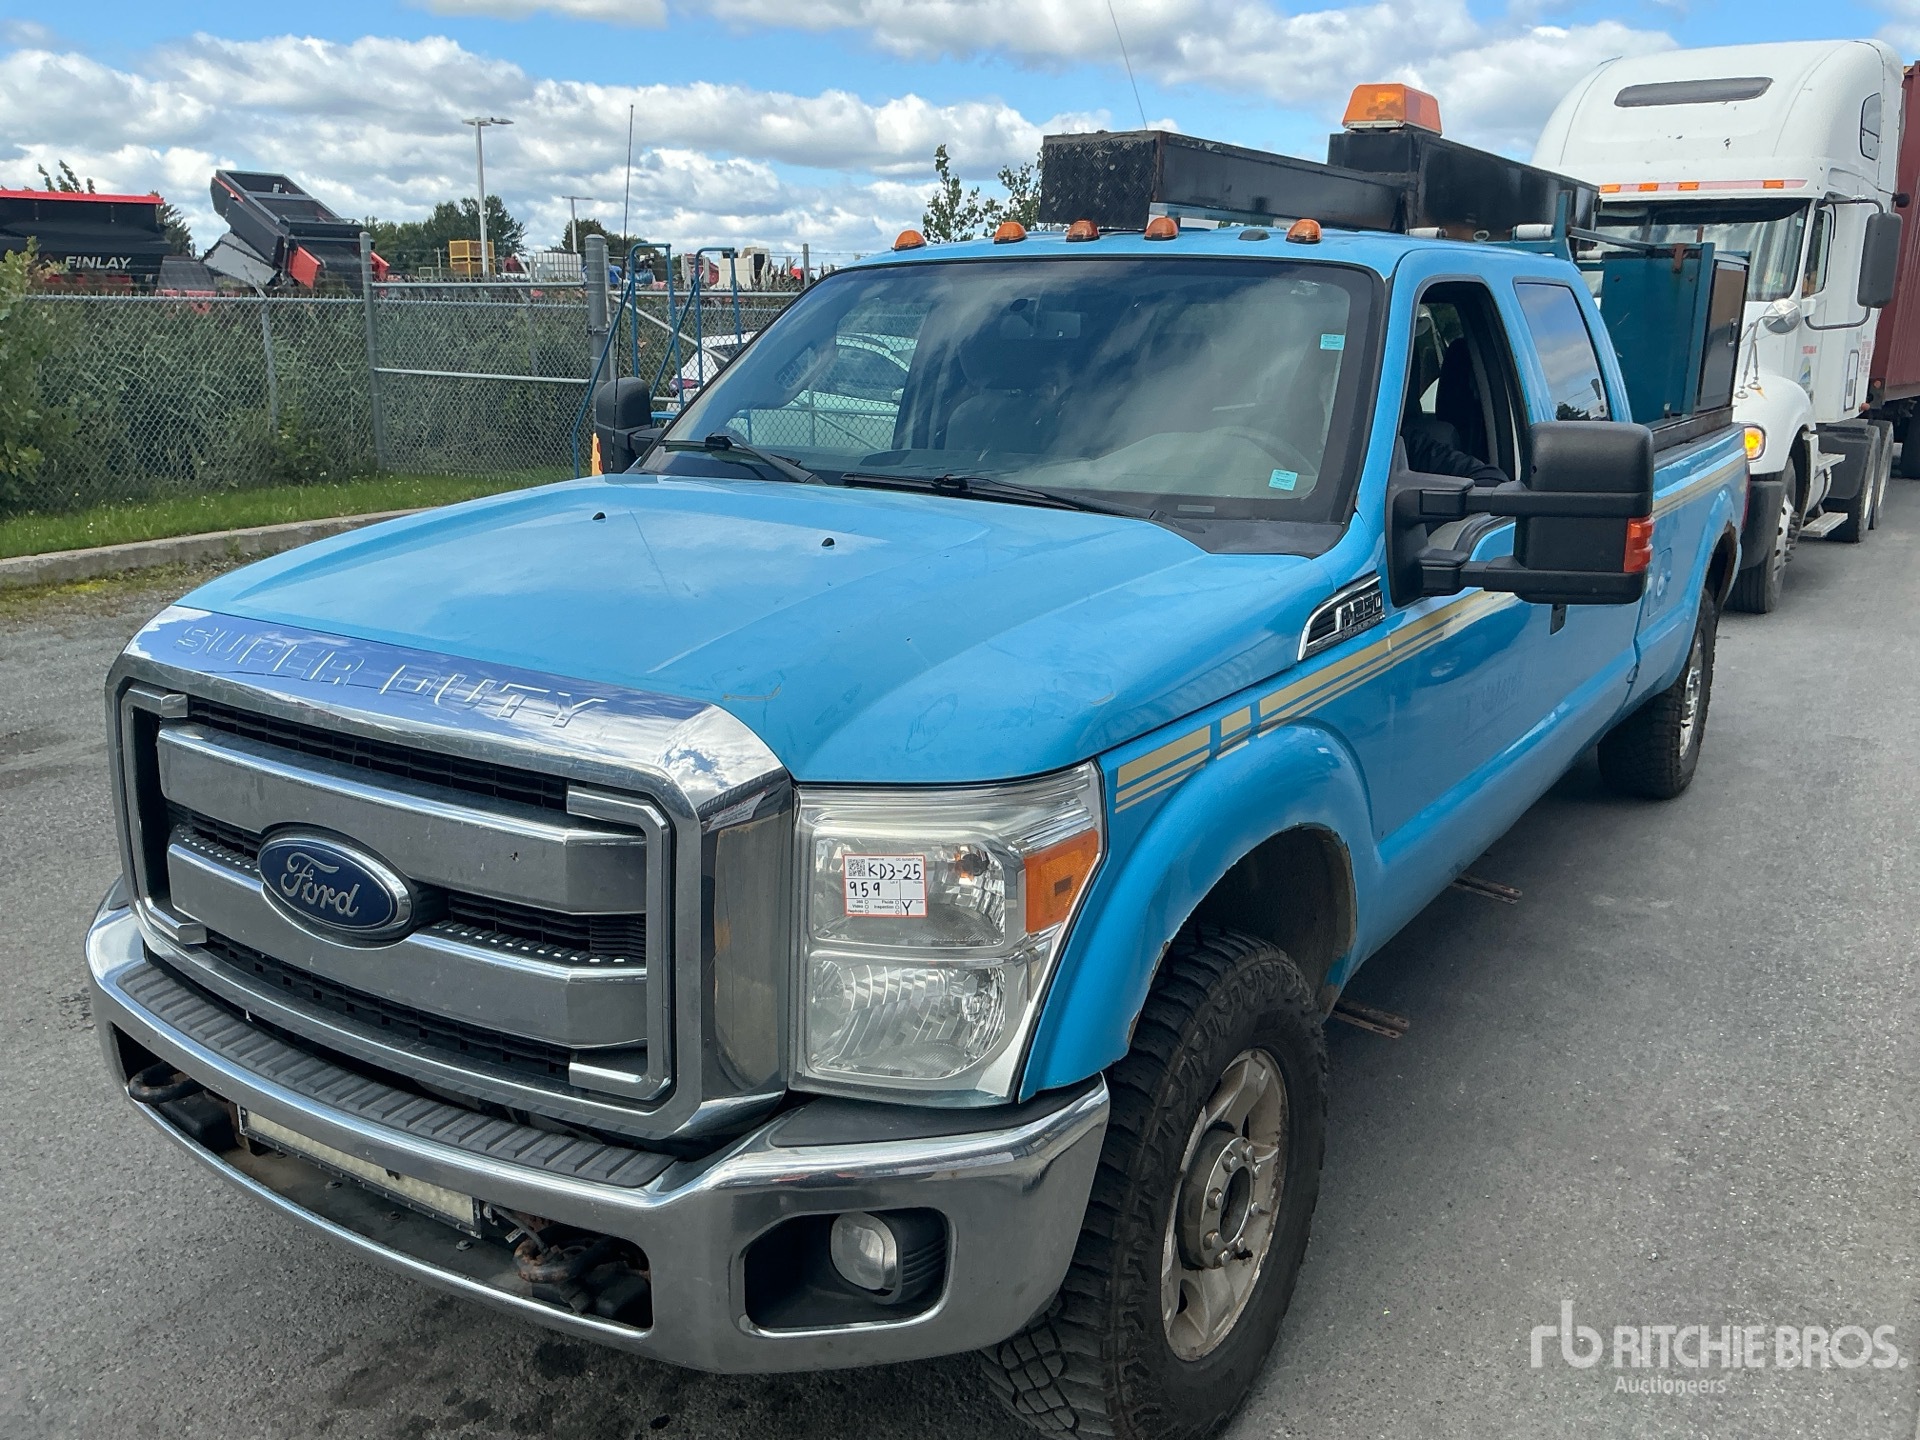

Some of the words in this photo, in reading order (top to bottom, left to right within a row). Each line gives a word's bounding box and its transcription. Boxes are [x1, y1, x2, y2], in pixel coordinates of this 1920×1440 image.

[65, 255, 132, 270] FINLAY
[173, 625, 366, 687] SUPER
[379, 664, 608, 729] DUTY
[868, 862, 922, 880] KD3-25
[280, 851, 361, 918] Ford
[849, 881, 881, 898] 959
[902, 900, 913, 916] Y
